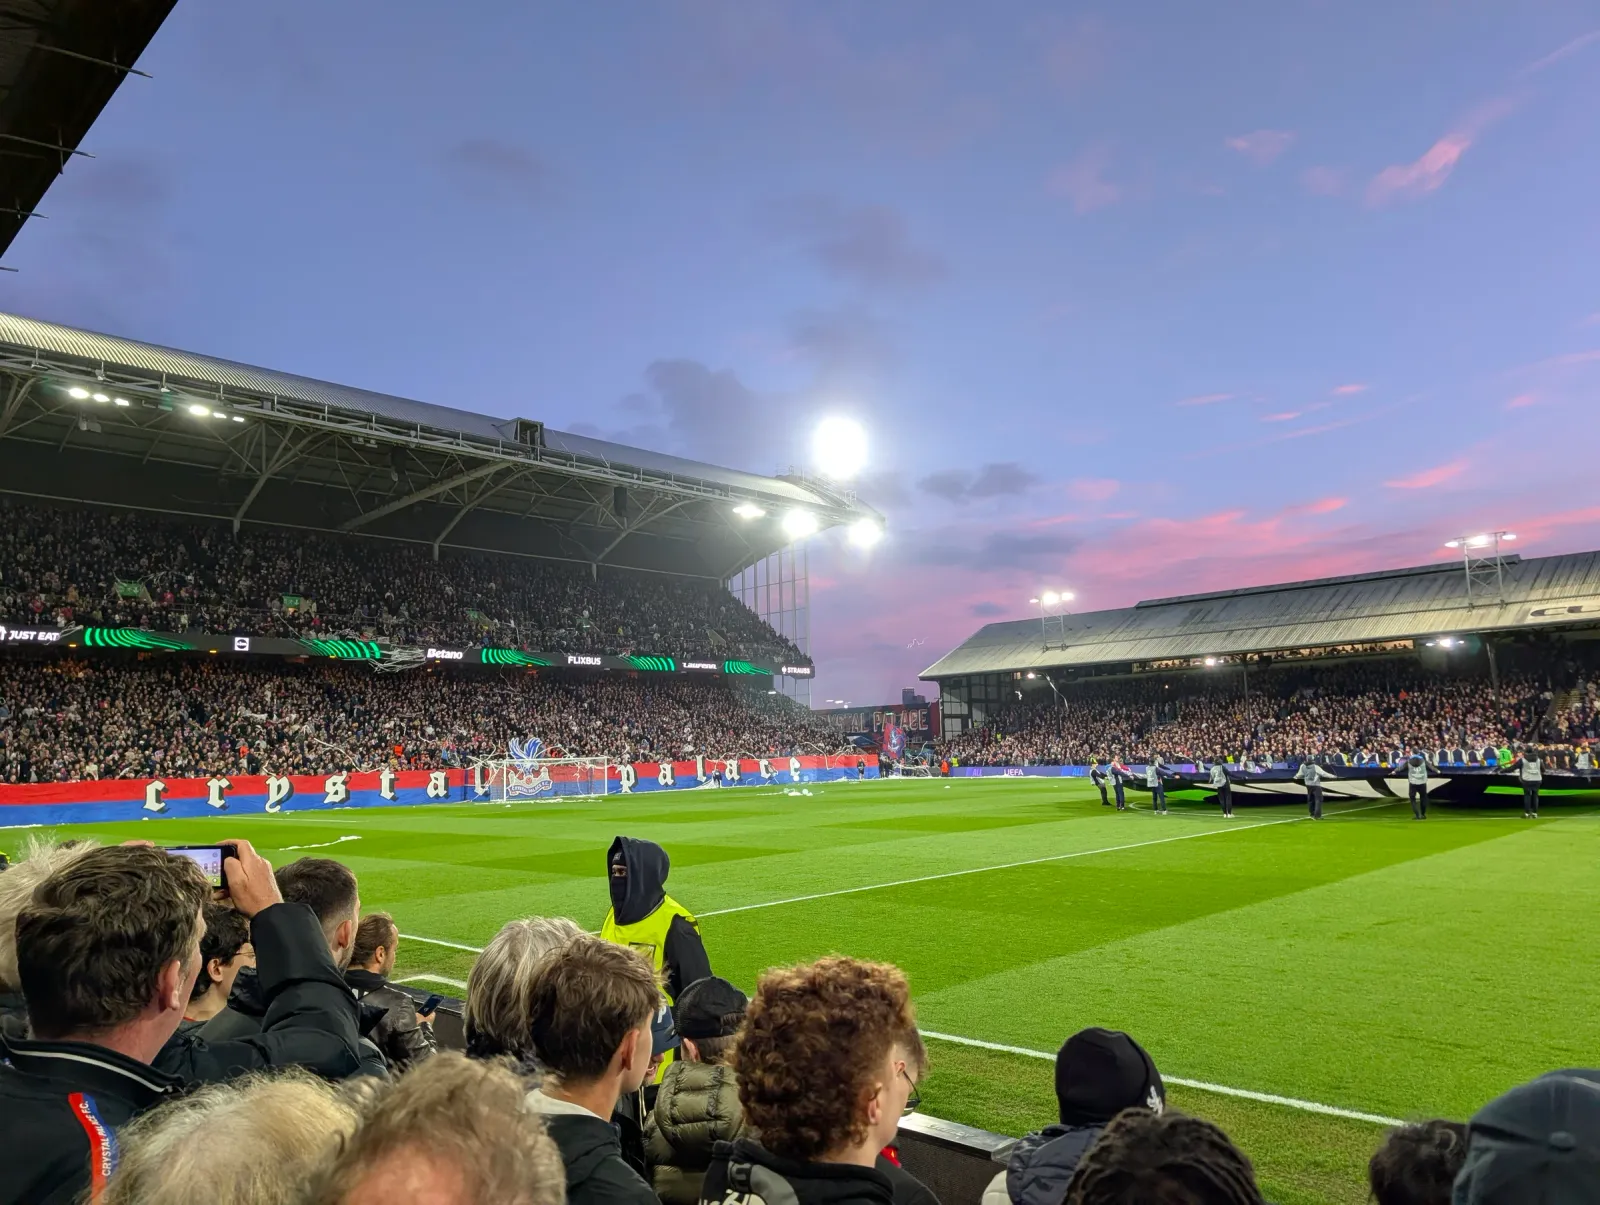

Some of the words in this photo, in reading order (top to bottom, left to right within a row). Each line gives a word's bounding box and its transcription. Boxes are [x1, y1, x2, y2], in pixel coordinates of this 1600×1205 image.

[8, 630, 37, 641] JUST
[38, 631, 60, 641] EAT
[427, 649, 463, 660] Betano
[568, 656, 601, 665] FLIXBUS
[787, 666, 811, 675] STRAUSS
[1003, 768, 1024, 777] UEFA
[79, 1101, 91, 1114] F.C.
[101, 1138, 111, 1177] CRYSTAL
